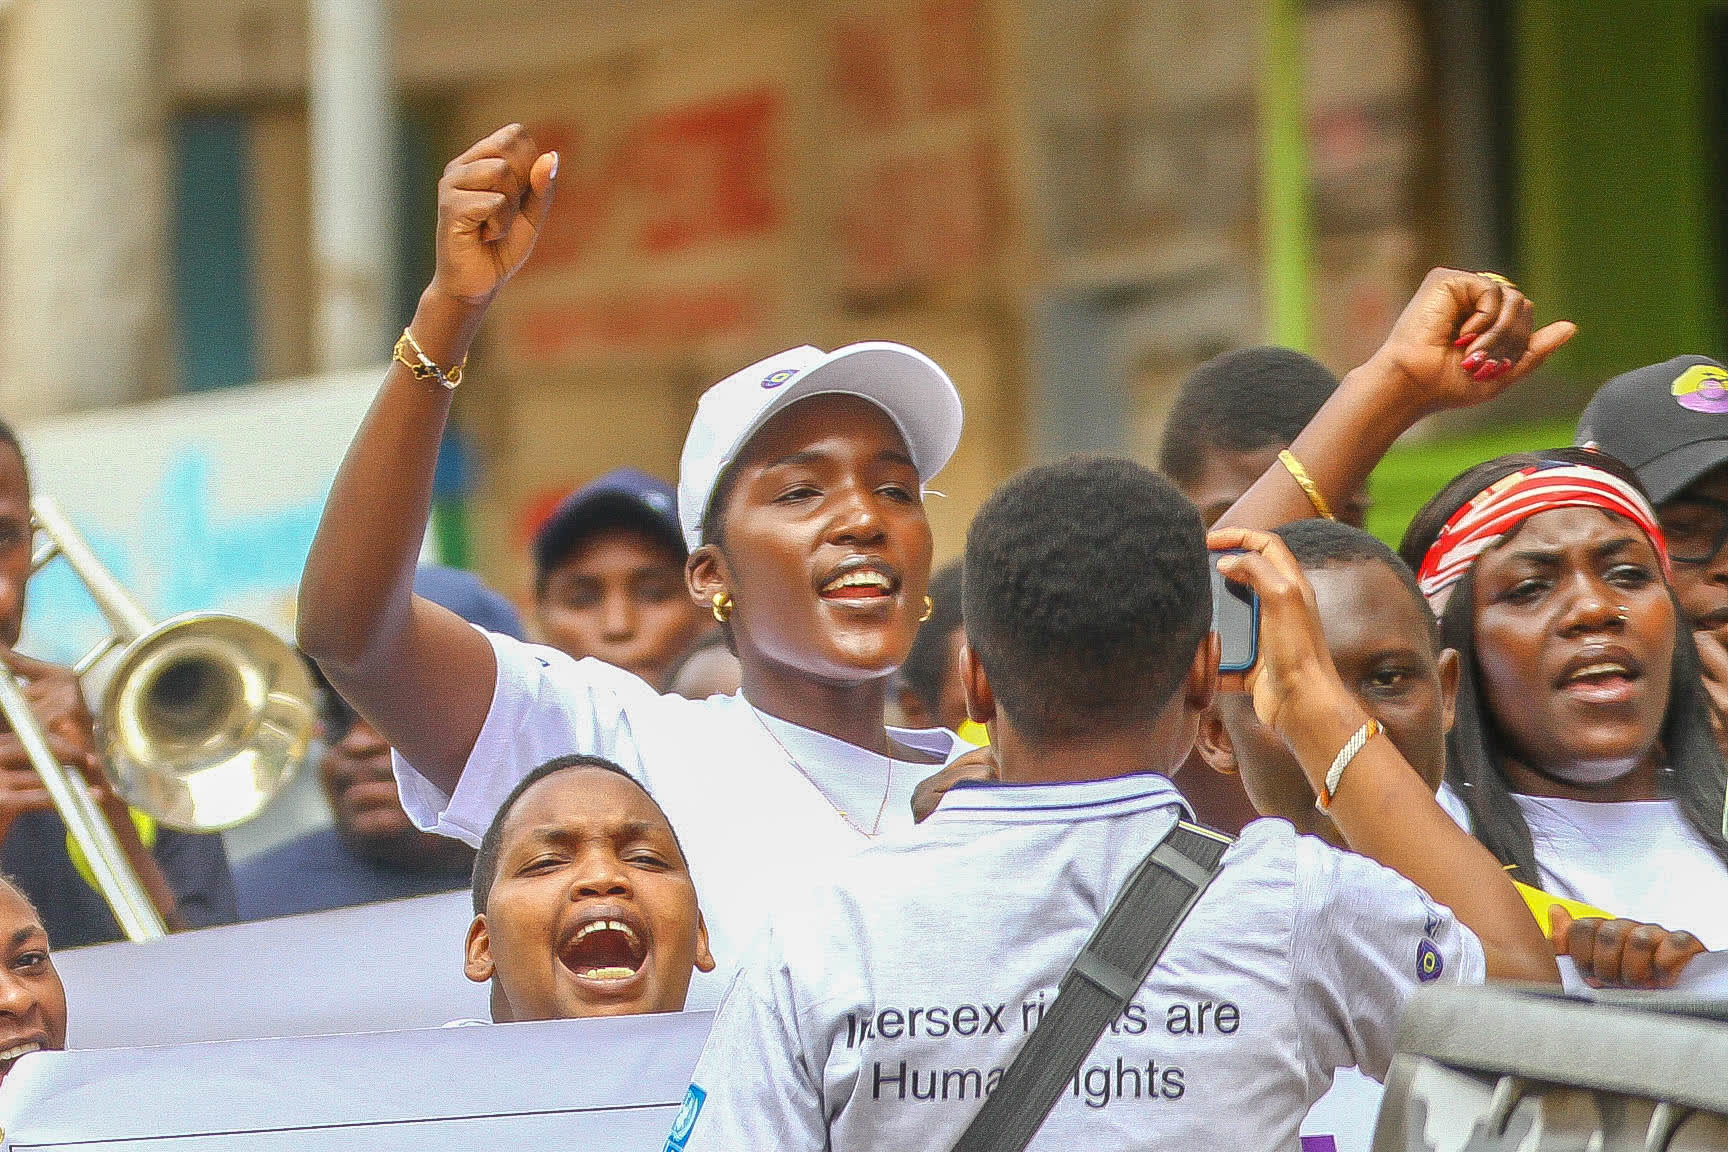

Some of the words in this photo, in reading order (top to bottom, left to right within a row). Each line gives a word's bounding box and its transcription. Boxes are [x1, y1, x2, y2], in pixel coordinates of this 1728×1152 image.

[1022, 991, 1148, 1034] ris
[1166, 1001, 1241, 1035] are
[872, 1060, 1005, 1100] Huma
[1072, 1056, 1186, 1108] ights
